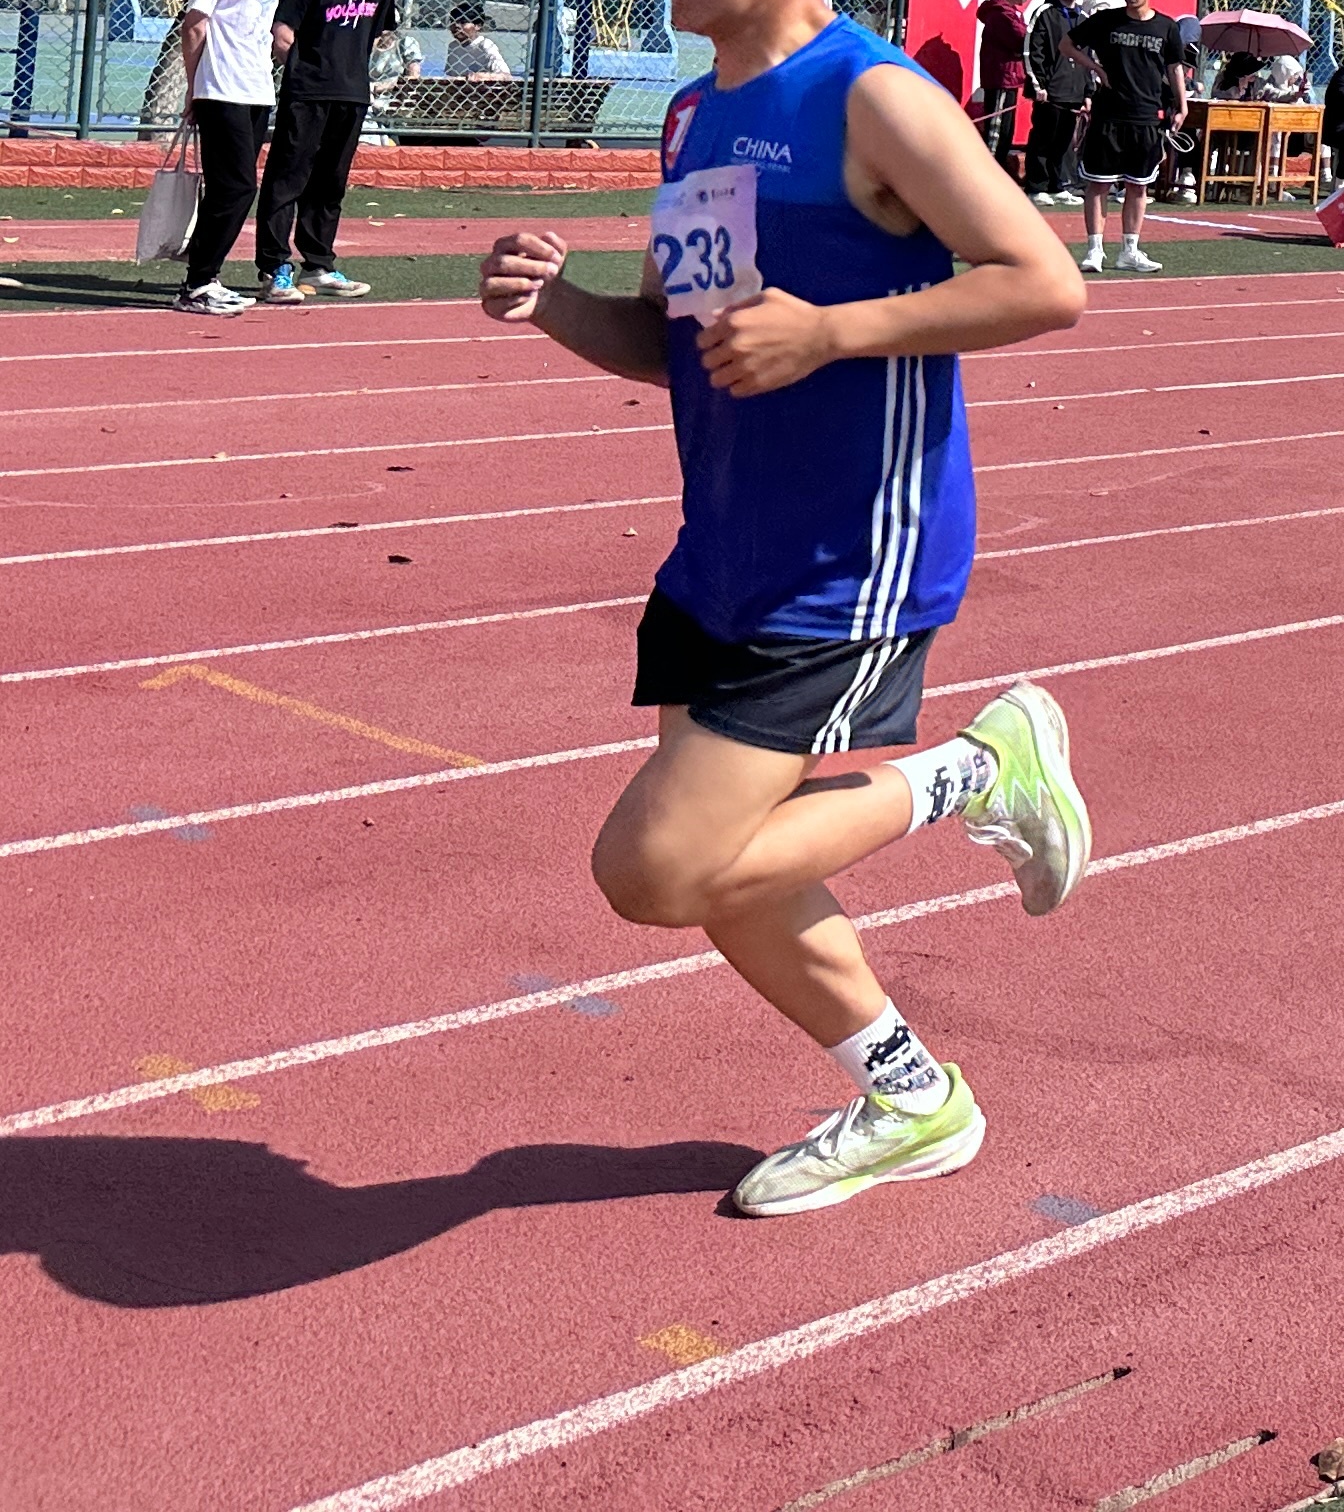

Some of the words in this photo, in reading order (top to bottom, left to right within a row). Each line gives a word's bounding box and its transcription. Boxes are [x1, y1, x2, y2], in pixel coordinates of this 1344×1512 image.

[668, 104, 697, 153] 1
[732, 136, 793, 164] CHINA
[653, 225, 735, 296] 233
